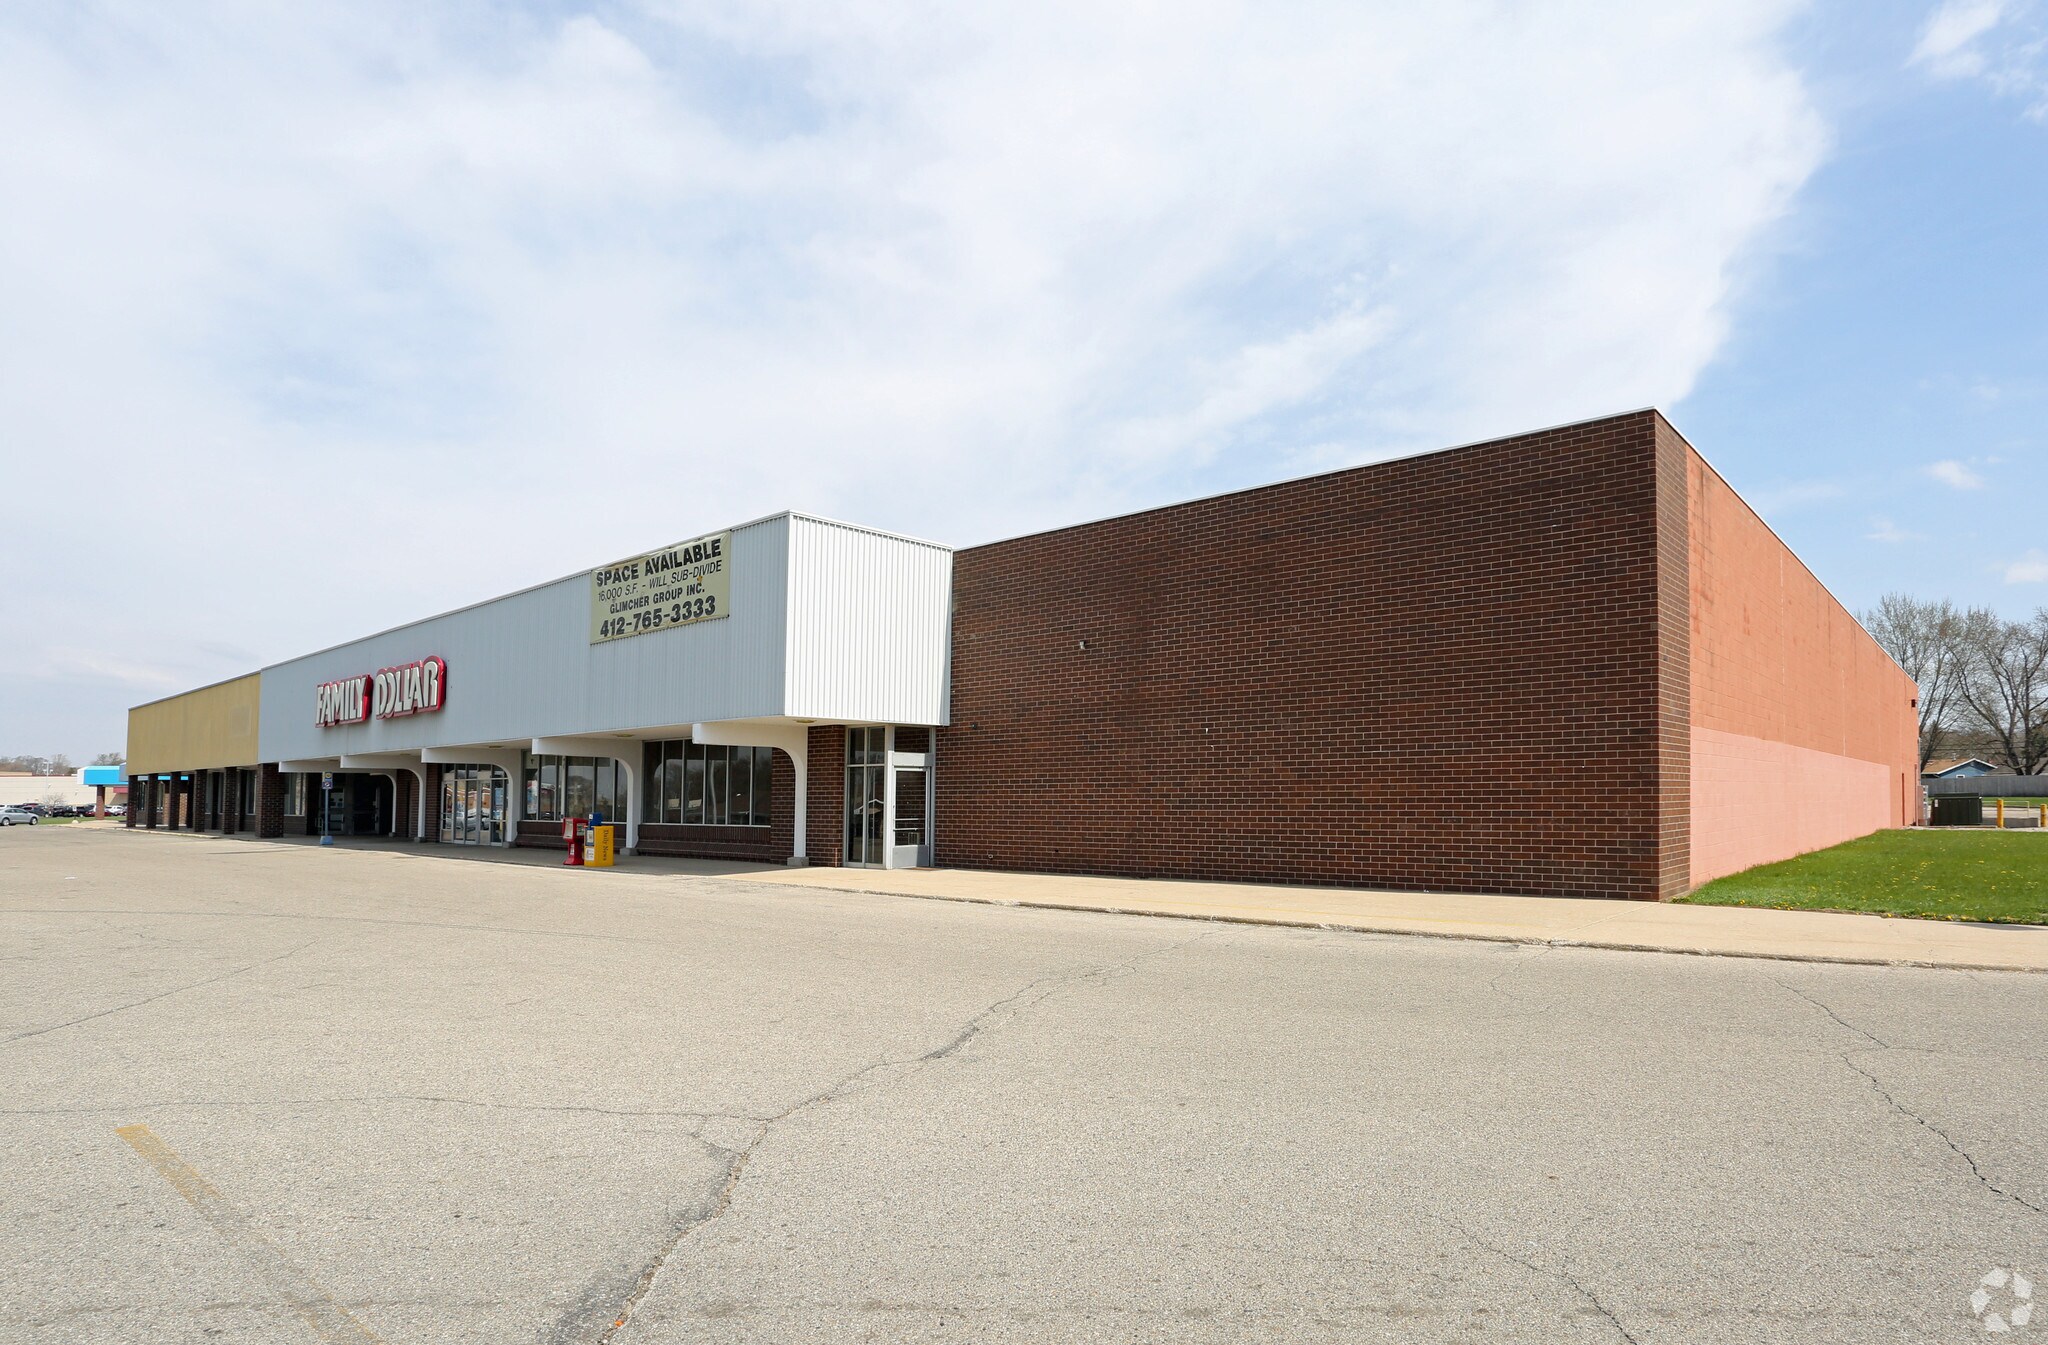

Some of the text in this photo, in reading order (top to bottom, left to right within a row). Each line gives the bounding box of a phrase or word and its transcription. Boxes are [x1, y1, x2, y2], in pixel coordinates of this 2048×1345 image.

[596, 538, 722, 588] SPACE AVAILABLE
[625, 583, 639, 596] S.F.
[649, 575, 668, 590] WILL
[671, 559, 722, 584] SUB-DIVIDE
[600, 595, 716, 638] 412-765-3333
[610, 582, 706, 614] GLIMCHER GROUP INC.
[315, 657, 441, 726] FAMILY DOLLAR
